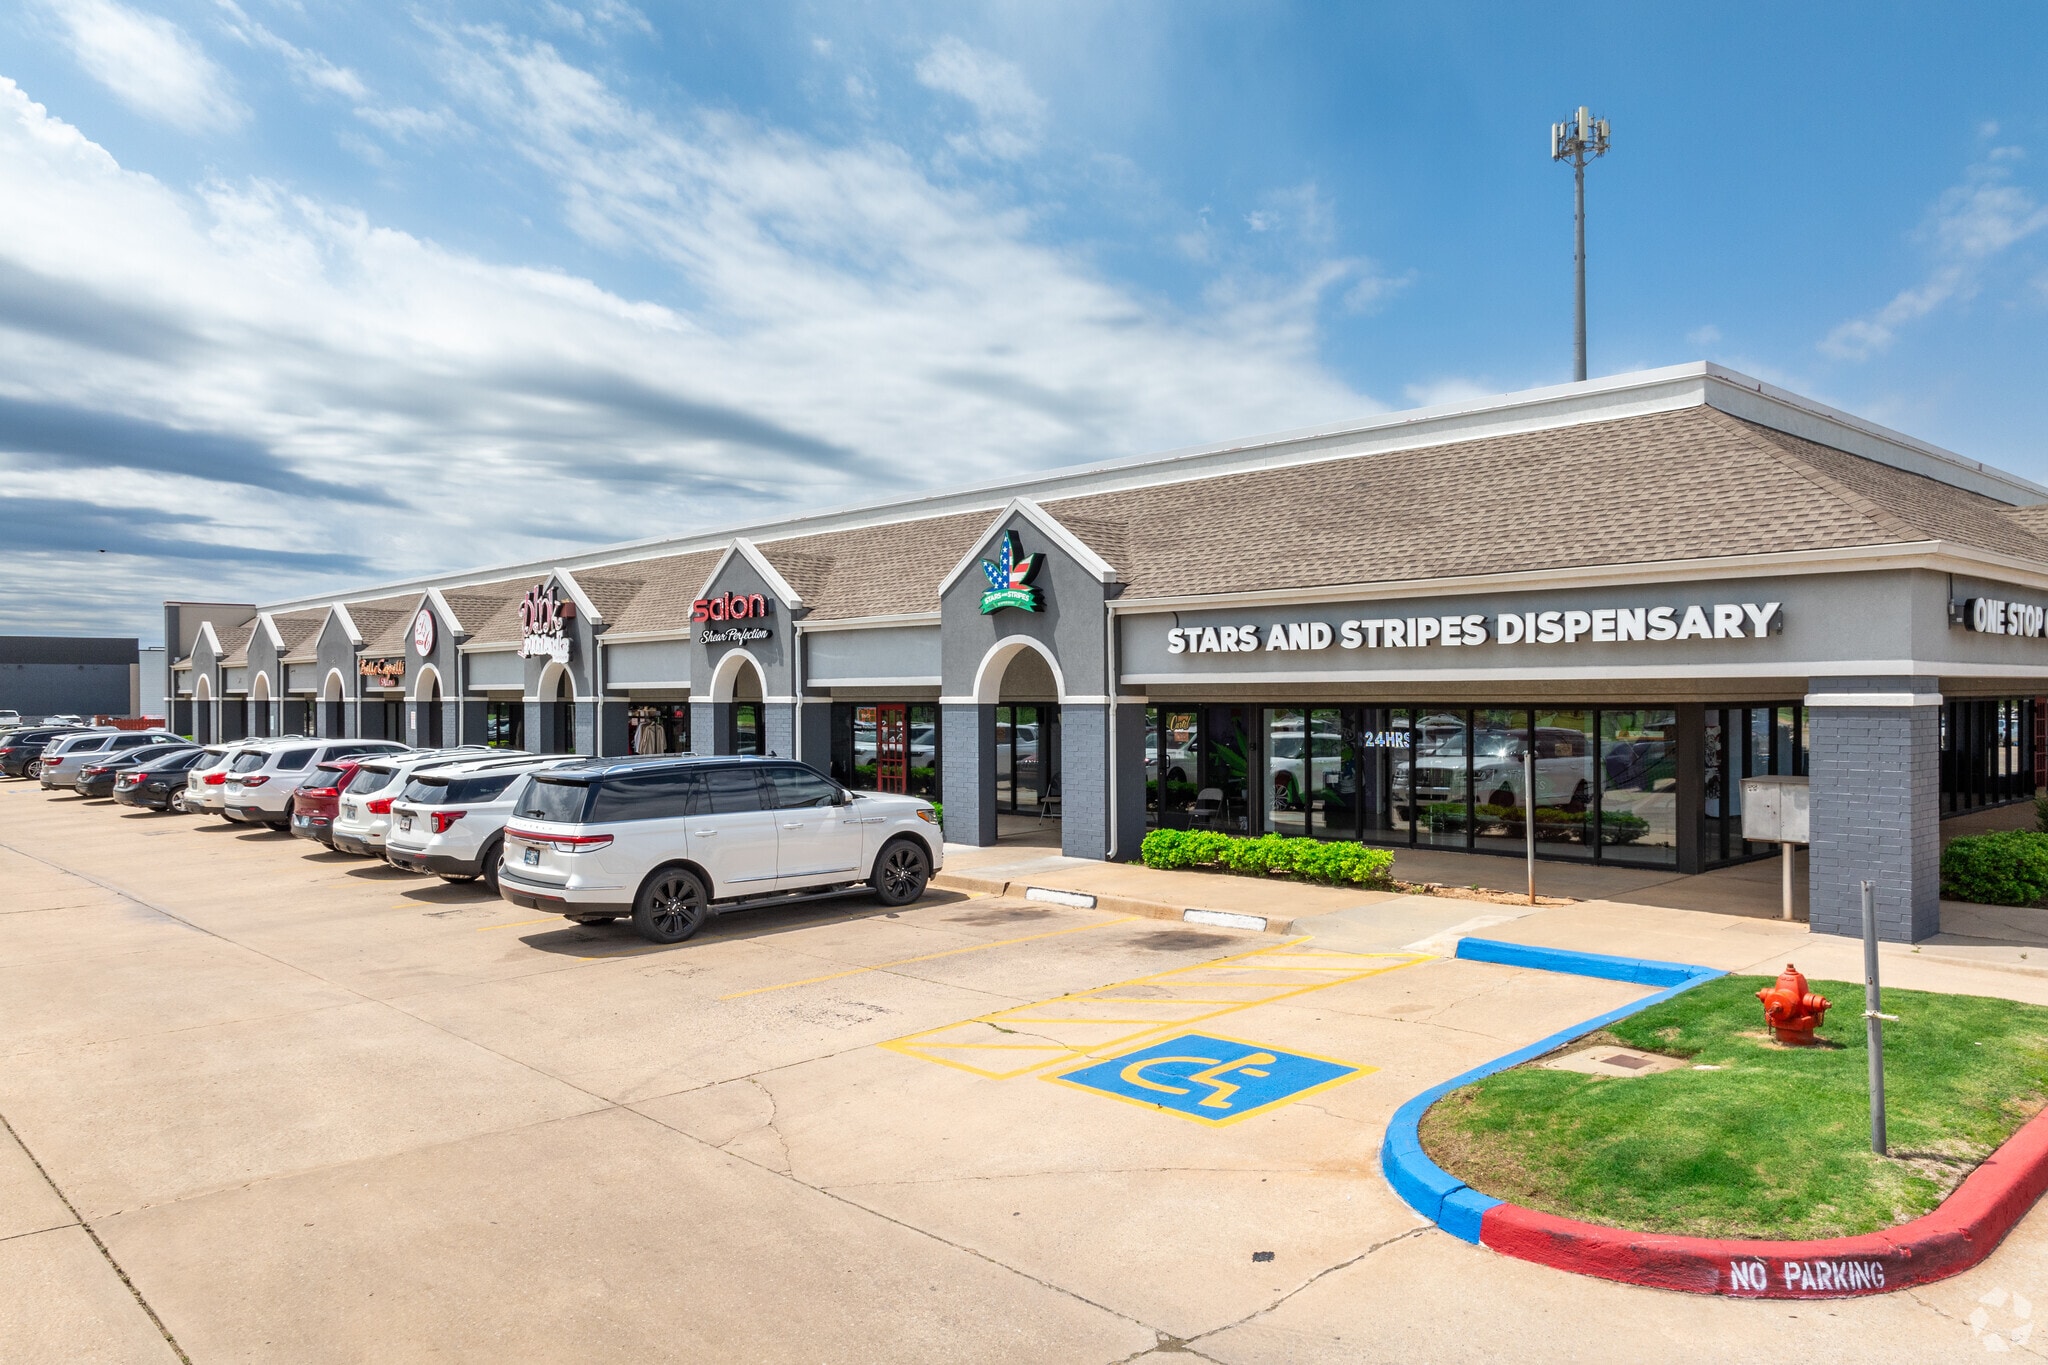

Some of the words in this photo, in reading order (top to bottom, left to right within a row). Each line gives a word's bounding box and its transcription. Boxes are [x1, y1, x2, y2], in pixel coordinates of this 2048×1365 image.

[693, 591, 765, 622] salon
[1974, 597, 2006, 634] ONE
[2007, 602, 2043, 638] STOP
[701, 630, 727, 644] Shear
[726, 628, 768, 646] Perfection
[1167, 625, 1258, 654] STARS
[1265, 622, 1332, 651] AND
[1340, 615, 1486, 649] STRIPES
[1497, 602, 1780, 644] DISPENSARY
[1730, 1261, 1767, 1291] NO
[1784, 1261, 1885, 1291] PARKING
